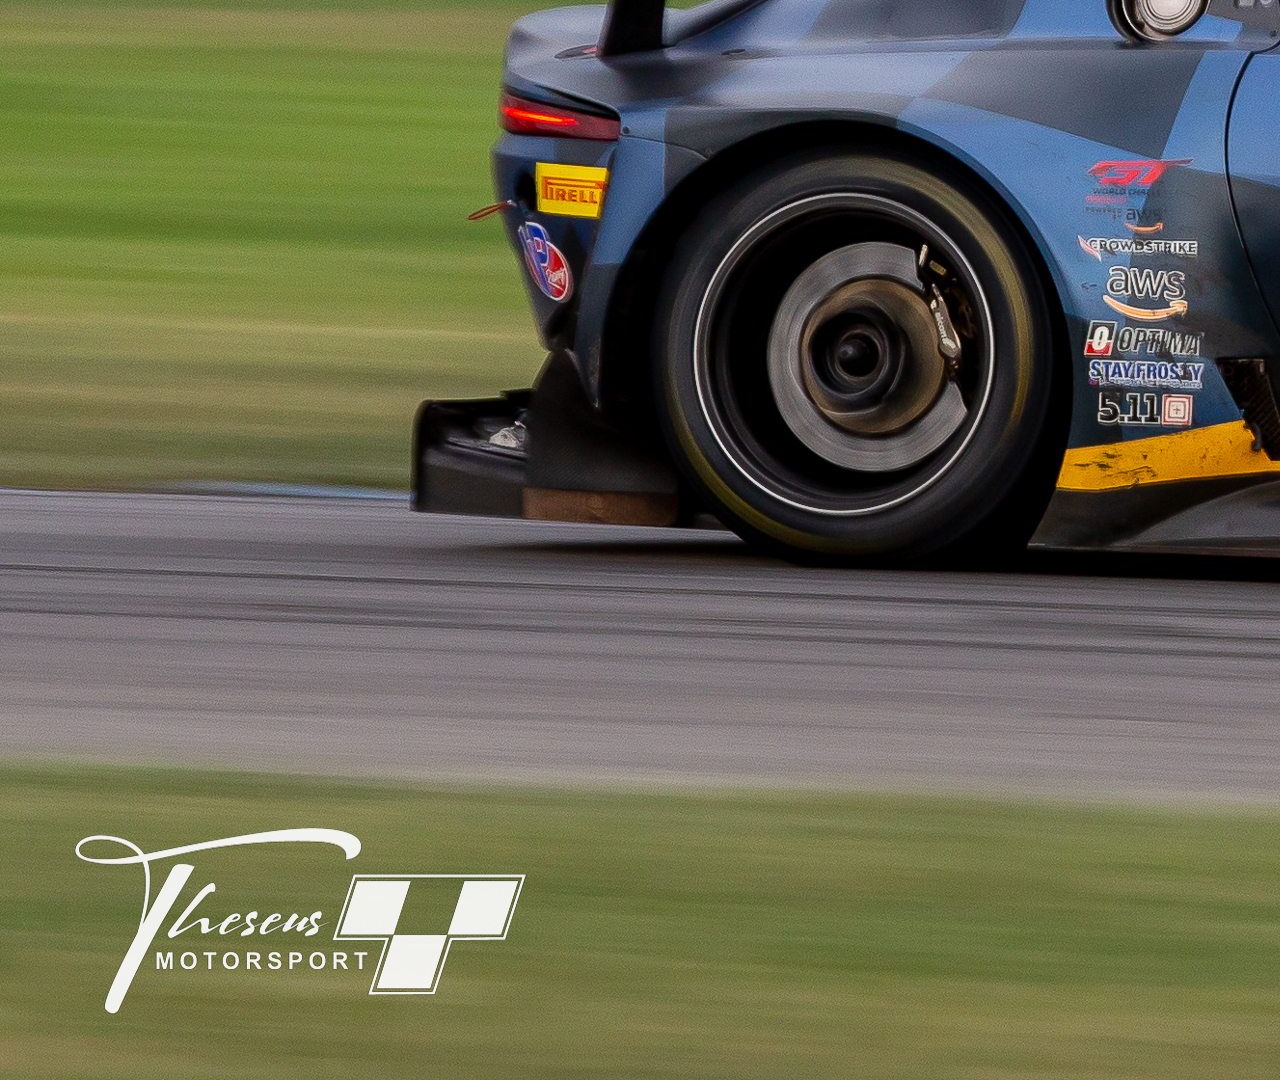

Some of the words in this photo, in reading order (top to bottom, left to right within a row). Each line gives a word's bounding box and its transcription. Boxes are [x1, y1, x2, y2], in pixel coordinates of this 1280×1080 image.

[540, 175, 607, 204] PIRELL
[1087, 239, 1197, 255] CROWDSTRIKE
[1106, 265, 1186, 301] aws
[1089, 360, 1133, 380] STAY
[1098, 392, 1160, 425] 5.11
